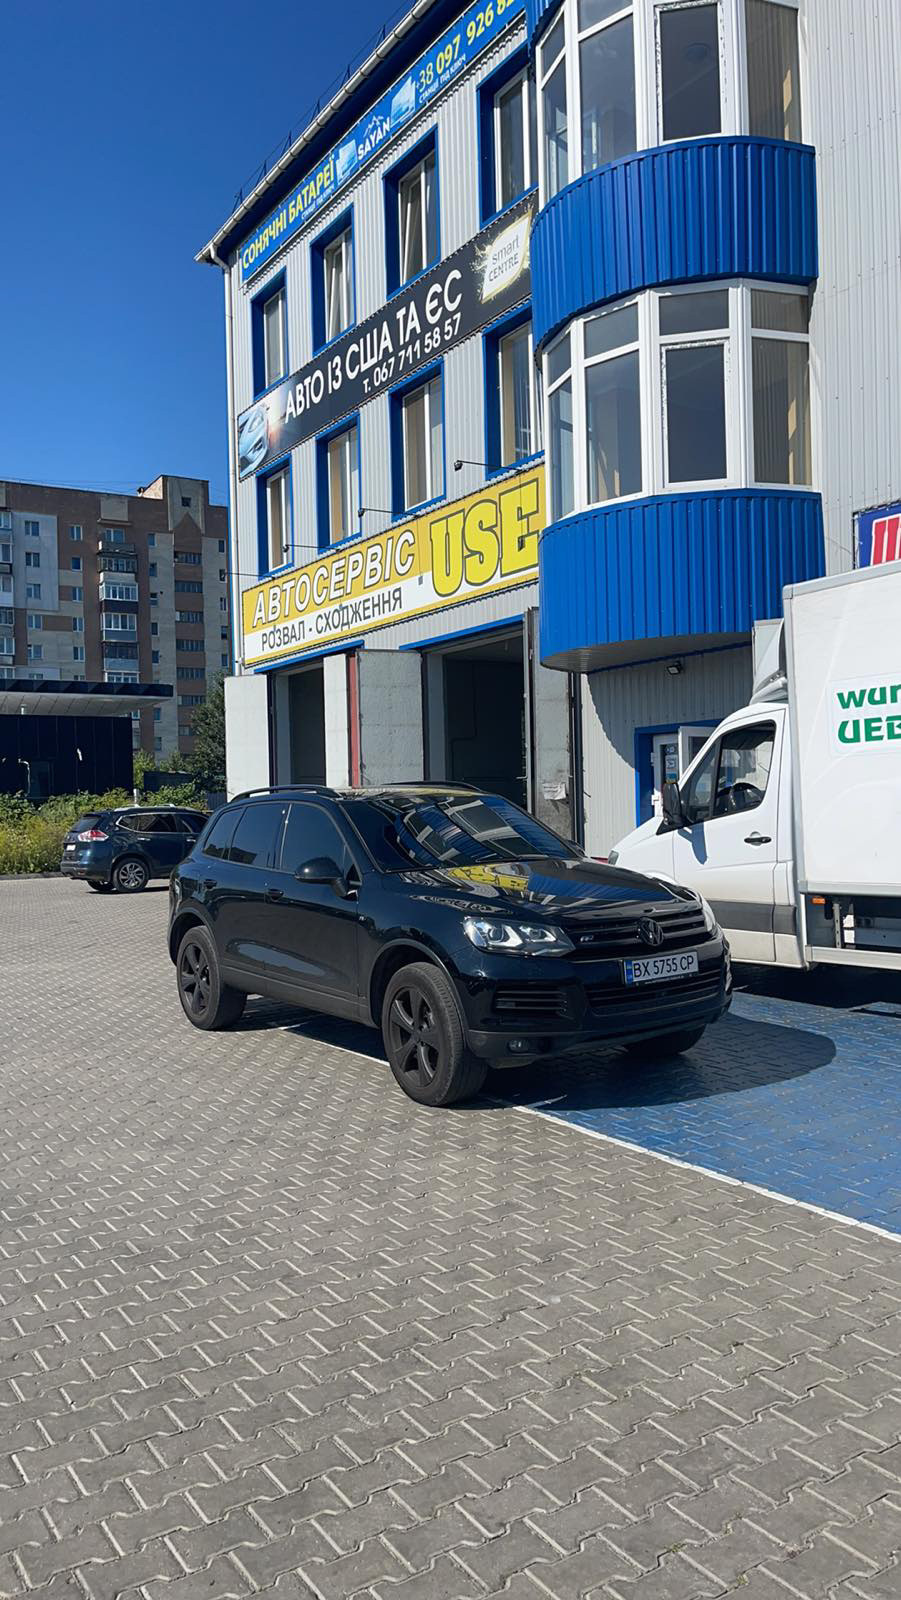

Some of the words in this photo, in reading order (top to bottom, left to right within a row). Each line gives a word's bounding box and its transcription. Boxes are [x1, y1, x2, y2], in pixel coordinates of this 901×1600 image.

[436, 34, 461, 74] 097
[466, 2, 494, 45] 926
[357, 116, 390, 160] SAYAN
[243, 209, 287, 269] СОНЯЧНІ
[288, 154, 335, 224] БАТАРЕЇ
[489, 252, 519, 282] CENTRE
[492, 235, 519, 265] smart
[285, 372, 324, 424] АВТО
[328, 357, 342, 395] ІЗ
[345, 321, 393, 380] США
[397, 300, 421, 346] ТА
[425, 269, 462, 325] ЄС
[374, 355, 395, 388] 067
[399, 339, 420, 371] 711
[424, 328, 441, 353] 58
[444, 312, 461, 341] 57
[429, 478, 540, 597] USE
[252, 529, 415, 628] АВТОСЕРВІС
[262, 619, 305, 652] РОЗВАЛ
[315, 587, 402, 634] СХОДЖЕННЯ
[633, 962, 650, 977] BX
[653, 957, 678, 974] 5755
[680, 955, 694, 970] CP
